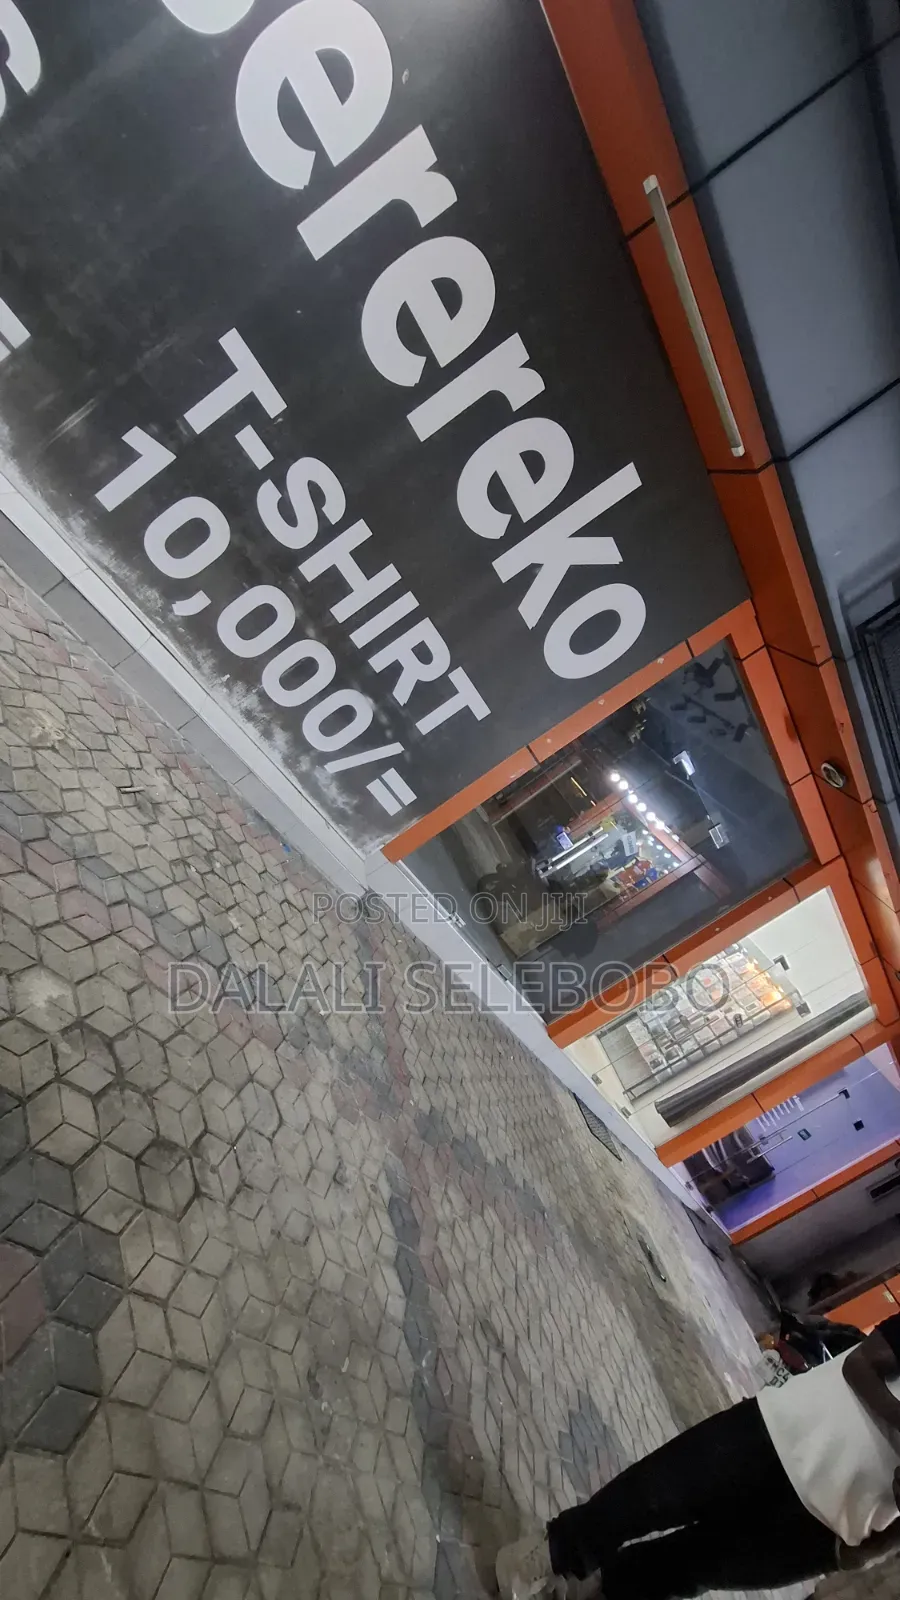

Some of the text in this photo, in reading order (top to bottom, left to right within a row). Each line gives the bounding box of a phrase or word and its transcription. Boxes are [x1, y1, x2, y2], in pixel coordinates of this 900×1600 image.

[161, 0, 646, 679] erereko
[184, 328, 491, 735] T-SHIRT
[95, 426, 417, 816] 10,000/=
